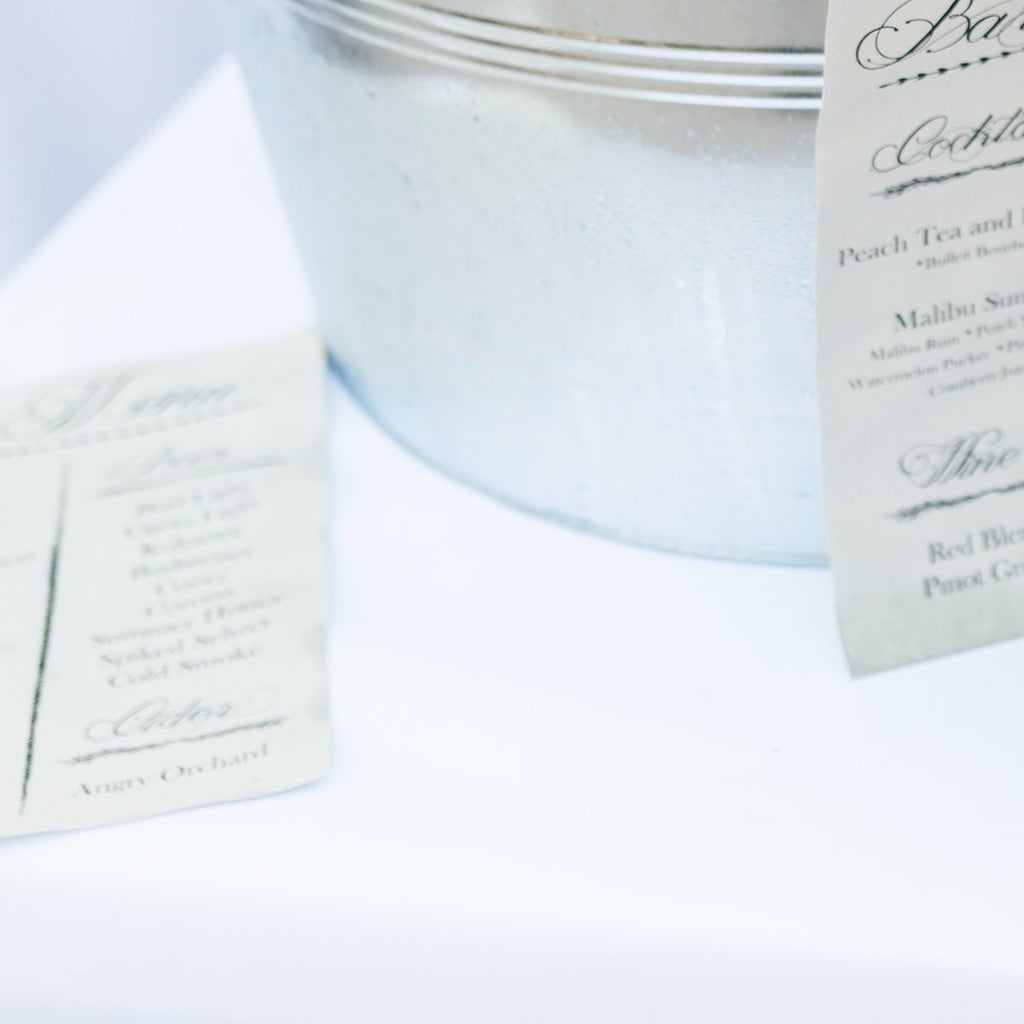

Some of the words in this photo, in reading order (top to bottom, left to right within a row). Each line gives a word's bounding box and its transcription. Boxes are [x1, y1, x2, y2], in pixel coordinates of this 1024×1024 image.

[839, 236, 908, 267] Peach
[917, 225, 962, 247] Tea
[970, 210, 1013, 236] and
[894, 301, 976, 333] Malibu
[927, 532, 978, 564] Red
[923, 570, 983, 600] Pinot
[107, 664, 170, 689] Cold
[72, 773, 150, 801] Angry
[160, 743, 270, 783] Orchard
